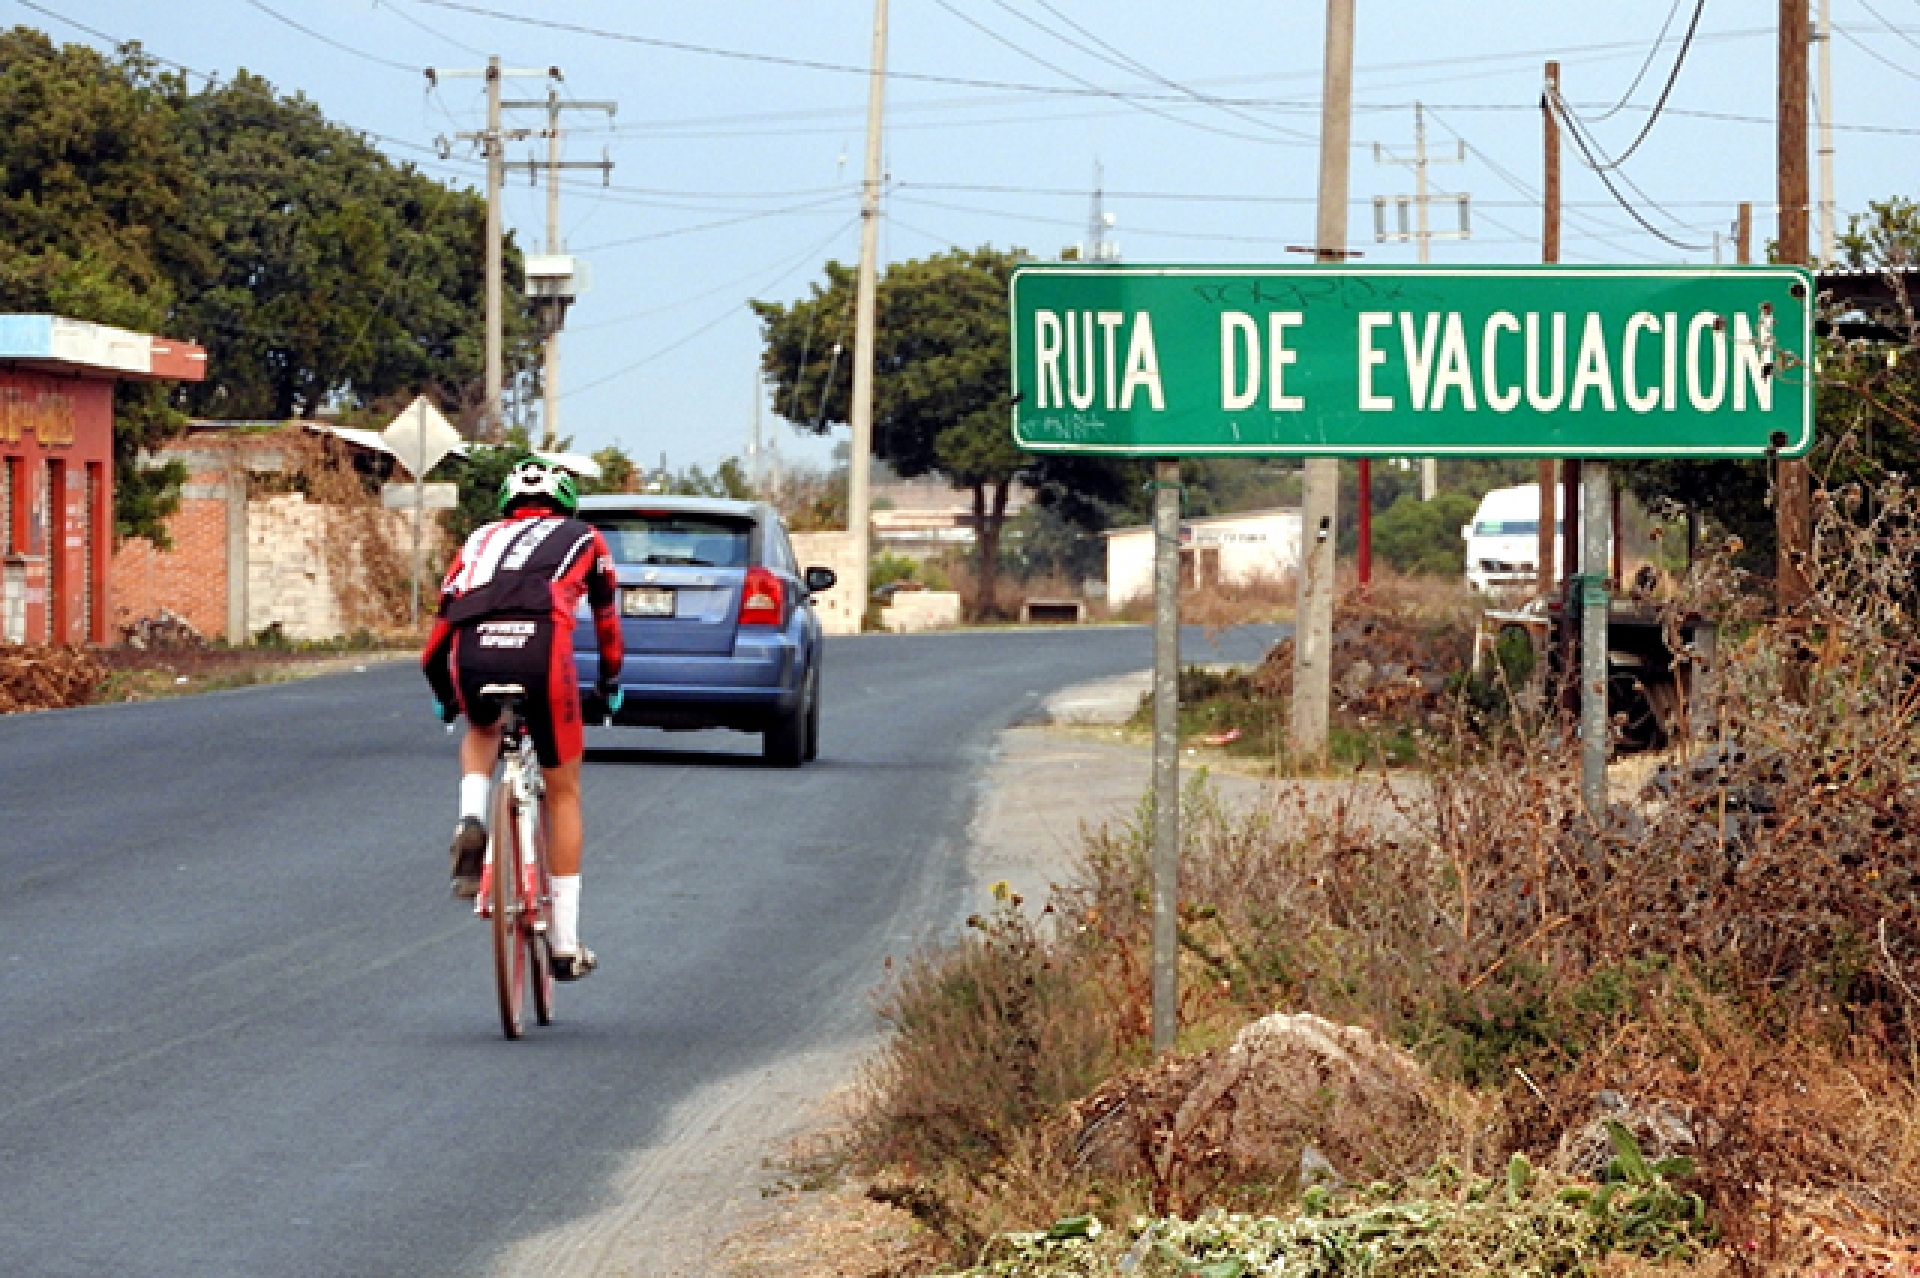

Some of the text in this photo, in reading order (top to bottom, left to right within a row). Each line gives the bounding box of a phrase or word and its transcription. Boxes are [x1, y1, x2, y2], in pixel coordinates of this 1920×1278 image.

[1034, 310, 1774, 413] RUTA DE EVACUACION
